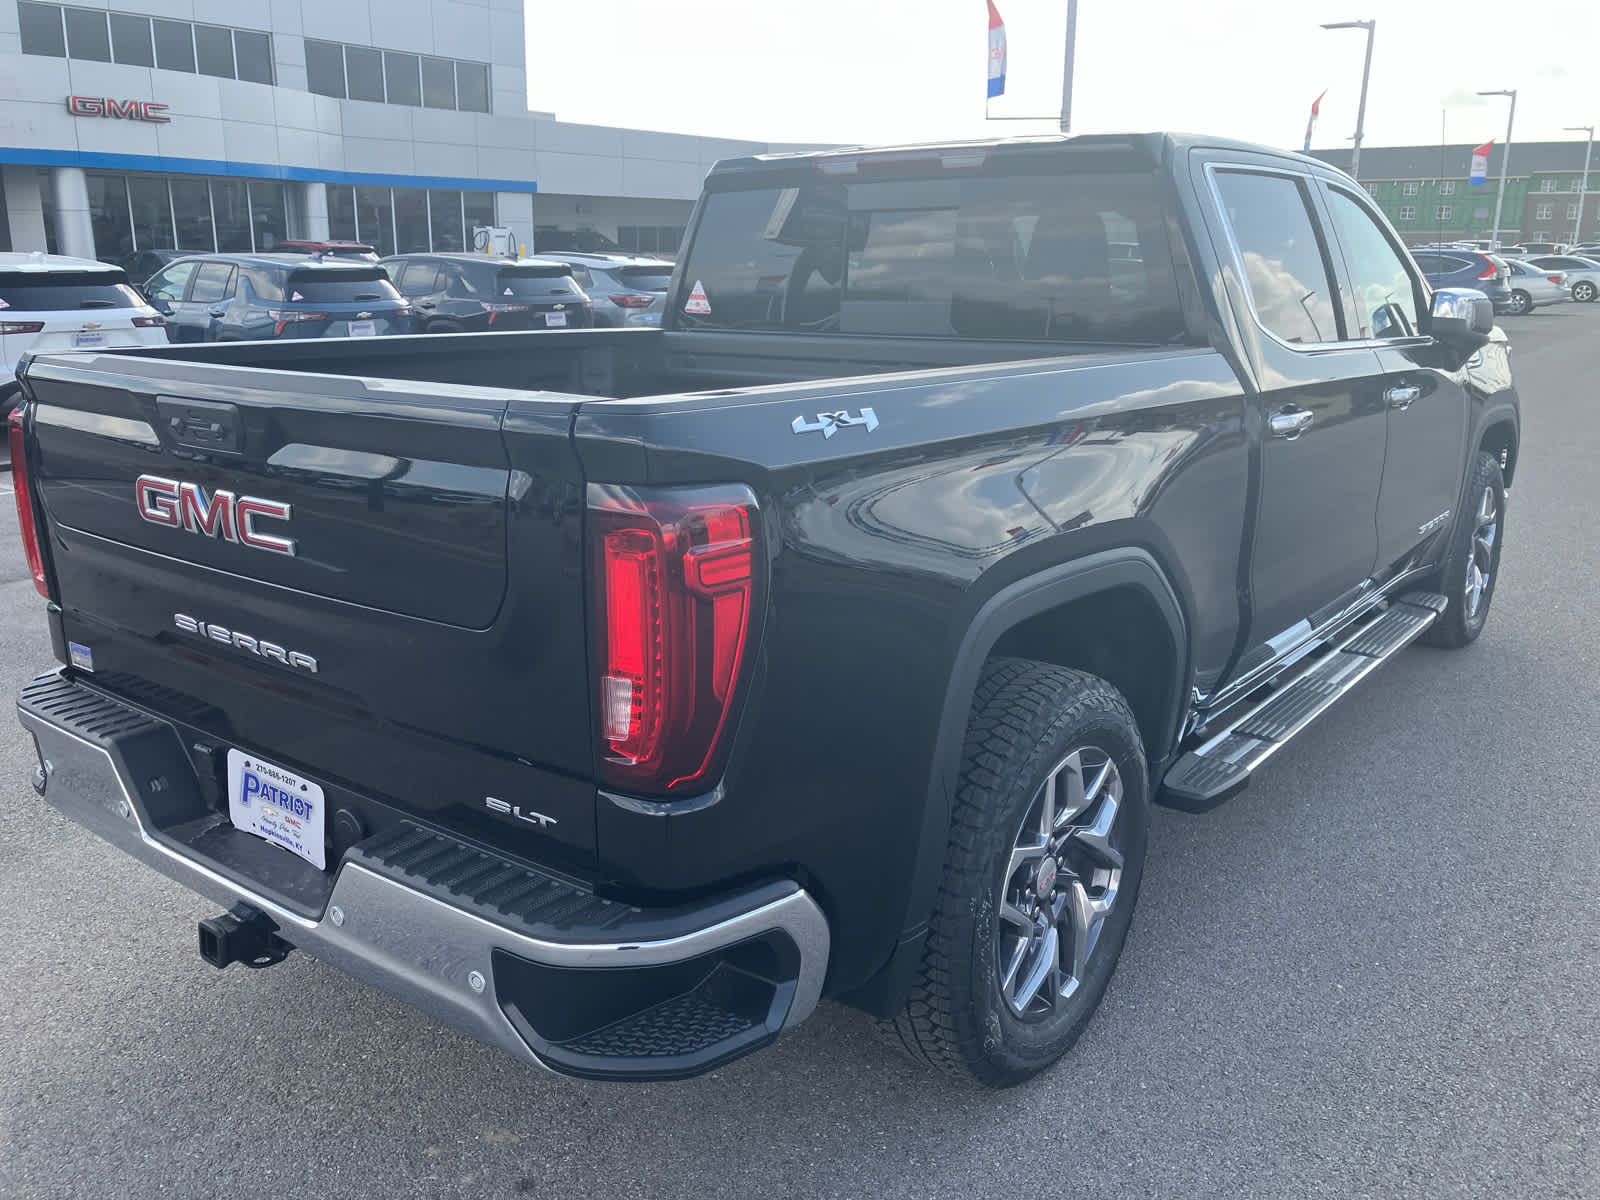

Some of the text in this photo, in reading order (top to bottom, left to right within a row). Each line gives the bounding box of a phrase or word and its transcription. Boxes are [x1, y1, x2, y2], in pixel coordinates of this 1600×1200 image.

[66, 95, 171, 123] GMC
[136, 474, 295, 557] GMC
[173, 613, 319, 673] SIERRA
[485, 796, 558, 828] SLT
